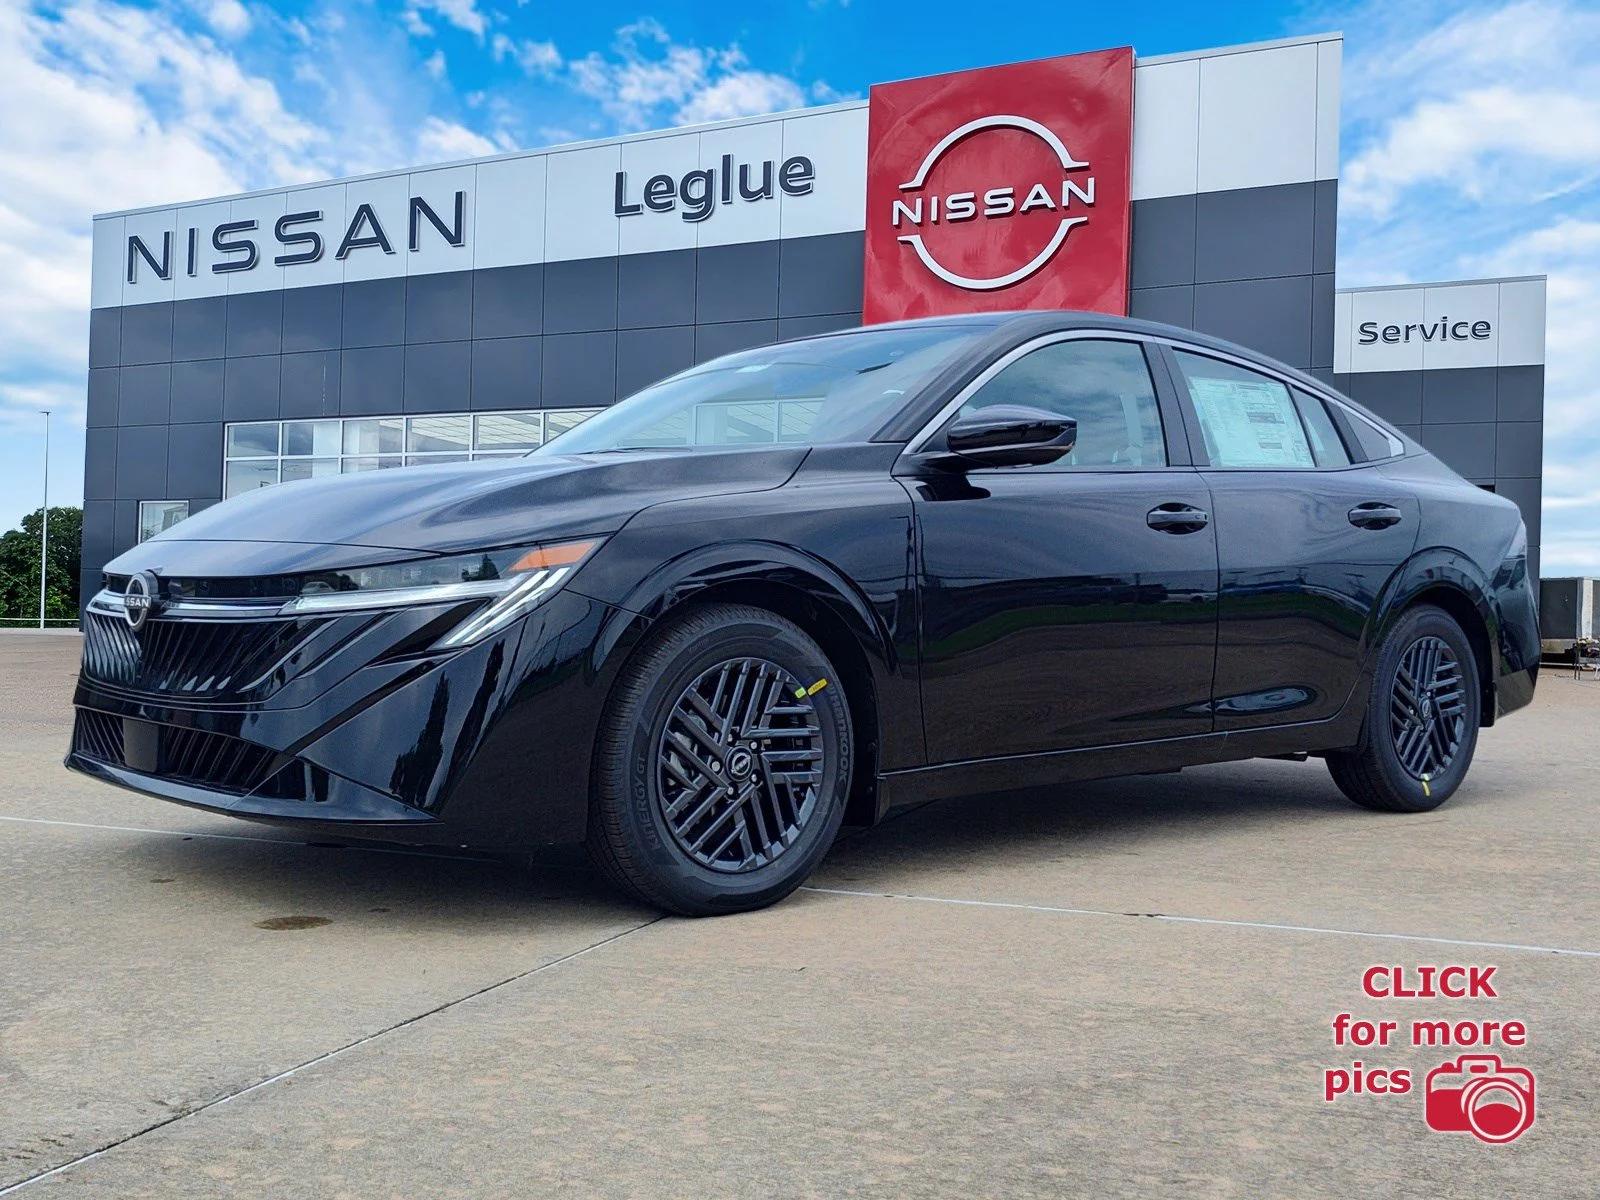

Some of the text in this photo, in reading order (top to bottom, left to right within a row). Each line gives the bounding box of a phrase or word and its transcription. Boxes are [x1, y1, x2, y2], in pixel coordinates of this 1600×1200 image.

[614, 153, 815, 222] Leglue
[892, 177, 1095, 227] NISSAN
[127, 190, 466, 284] NISSAN
[1358, 316, 1492, 345] Service
